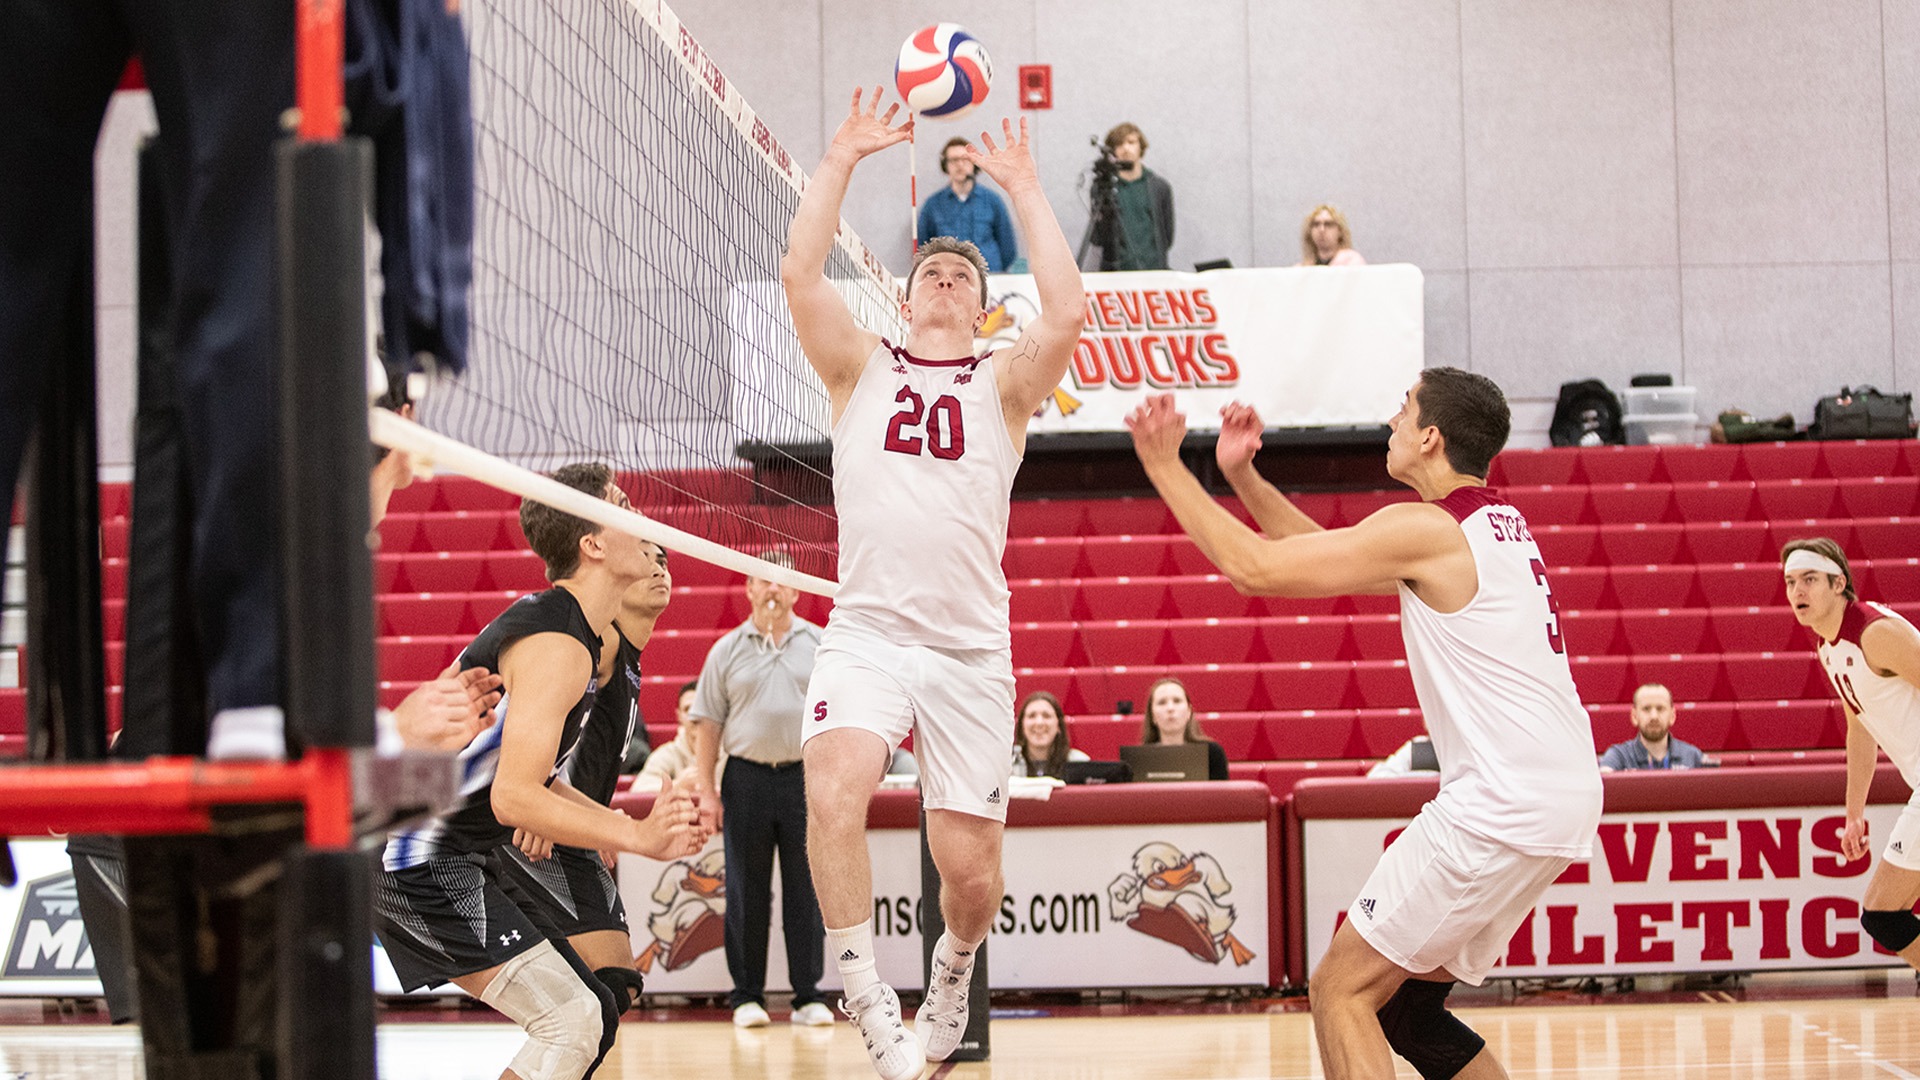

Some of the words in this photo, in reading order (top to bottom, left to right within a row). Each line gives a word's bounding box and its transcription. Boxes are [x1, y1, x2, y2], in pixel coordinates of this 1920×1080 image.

[1084, 289, 1217, 330] TEVENS
[1070, 334, 1239, 390] DUCKS
[884, 384, 965, 461] 20
[814, 701, 828, 722] S
[1384, 816, 1871, 886] VENS
